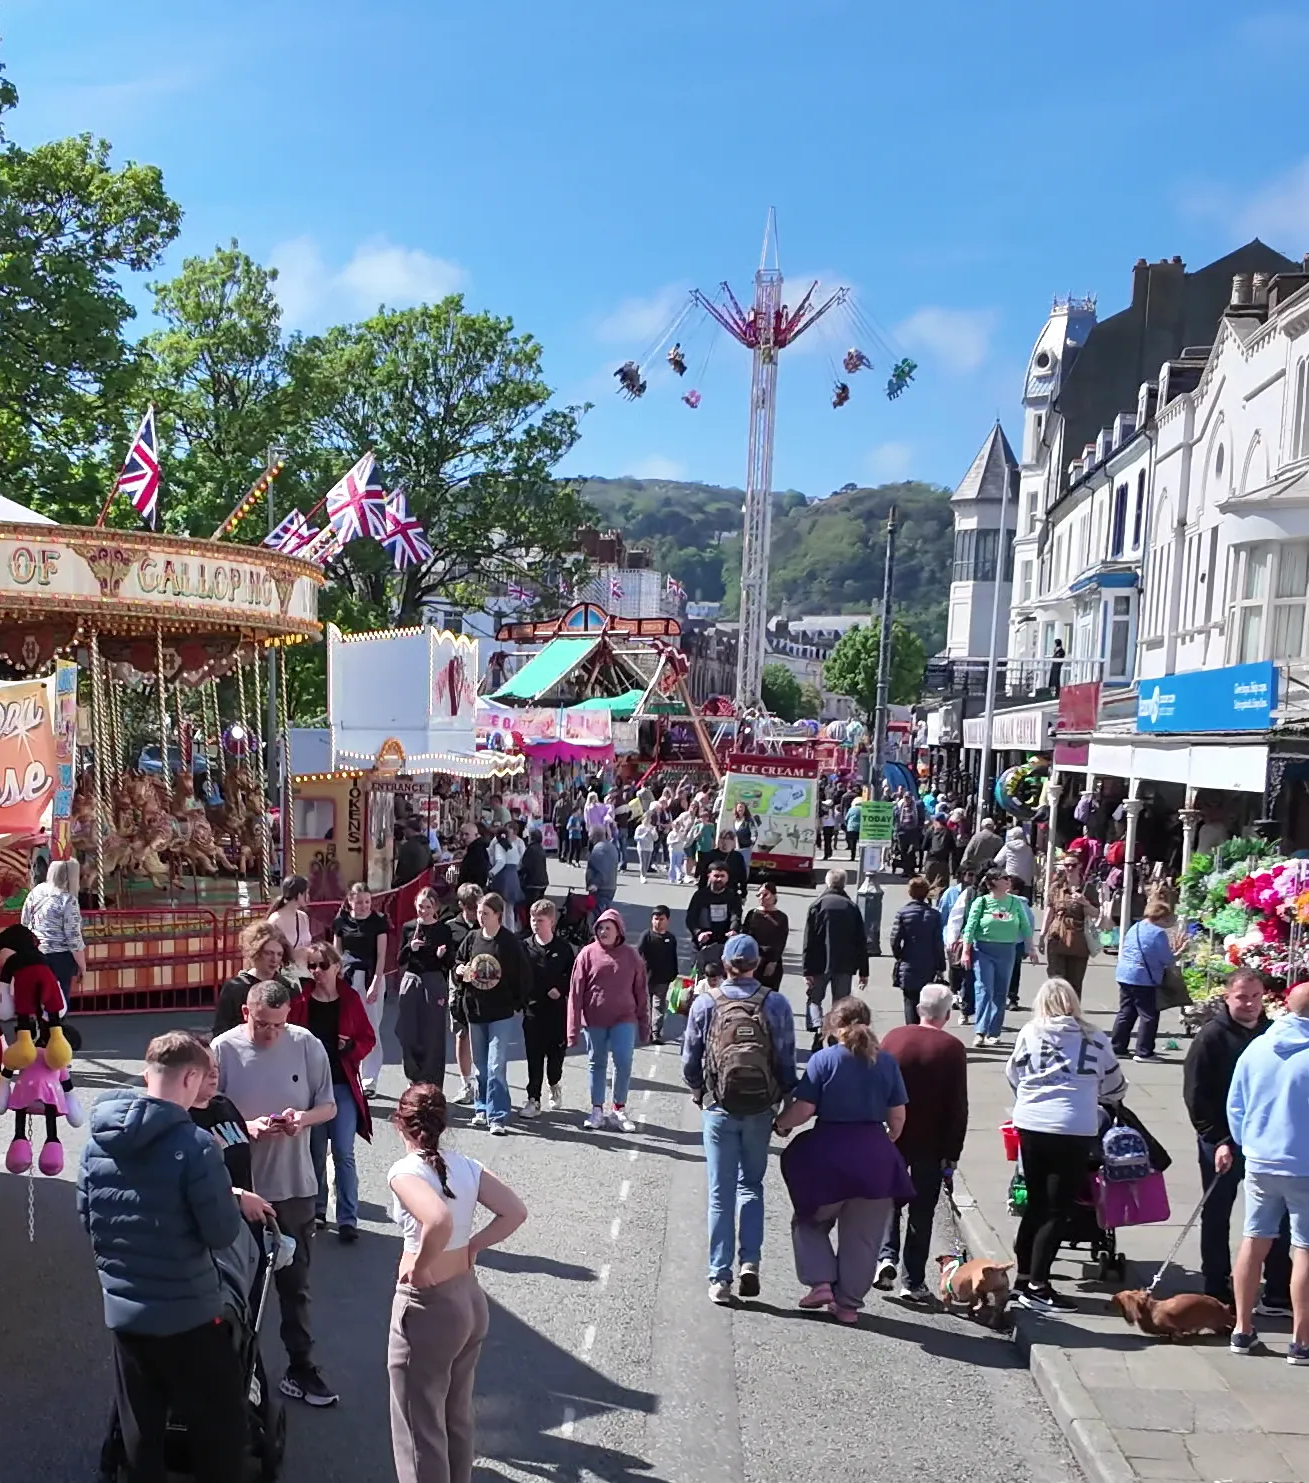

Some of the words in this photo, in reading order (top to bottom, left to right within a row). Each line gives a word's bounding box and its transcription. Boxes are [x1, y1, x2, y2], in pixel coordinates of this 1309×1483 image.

[9, 545, 60, 585] OF
[137, 558, 272, 606] GALLOPING
[741, 765, 759, 773] ICE
[762, 766, 804, 777] CREAM
[371, 782, 425, 792] ENTRANCE
[862, 815, 892, 823] TODAY
